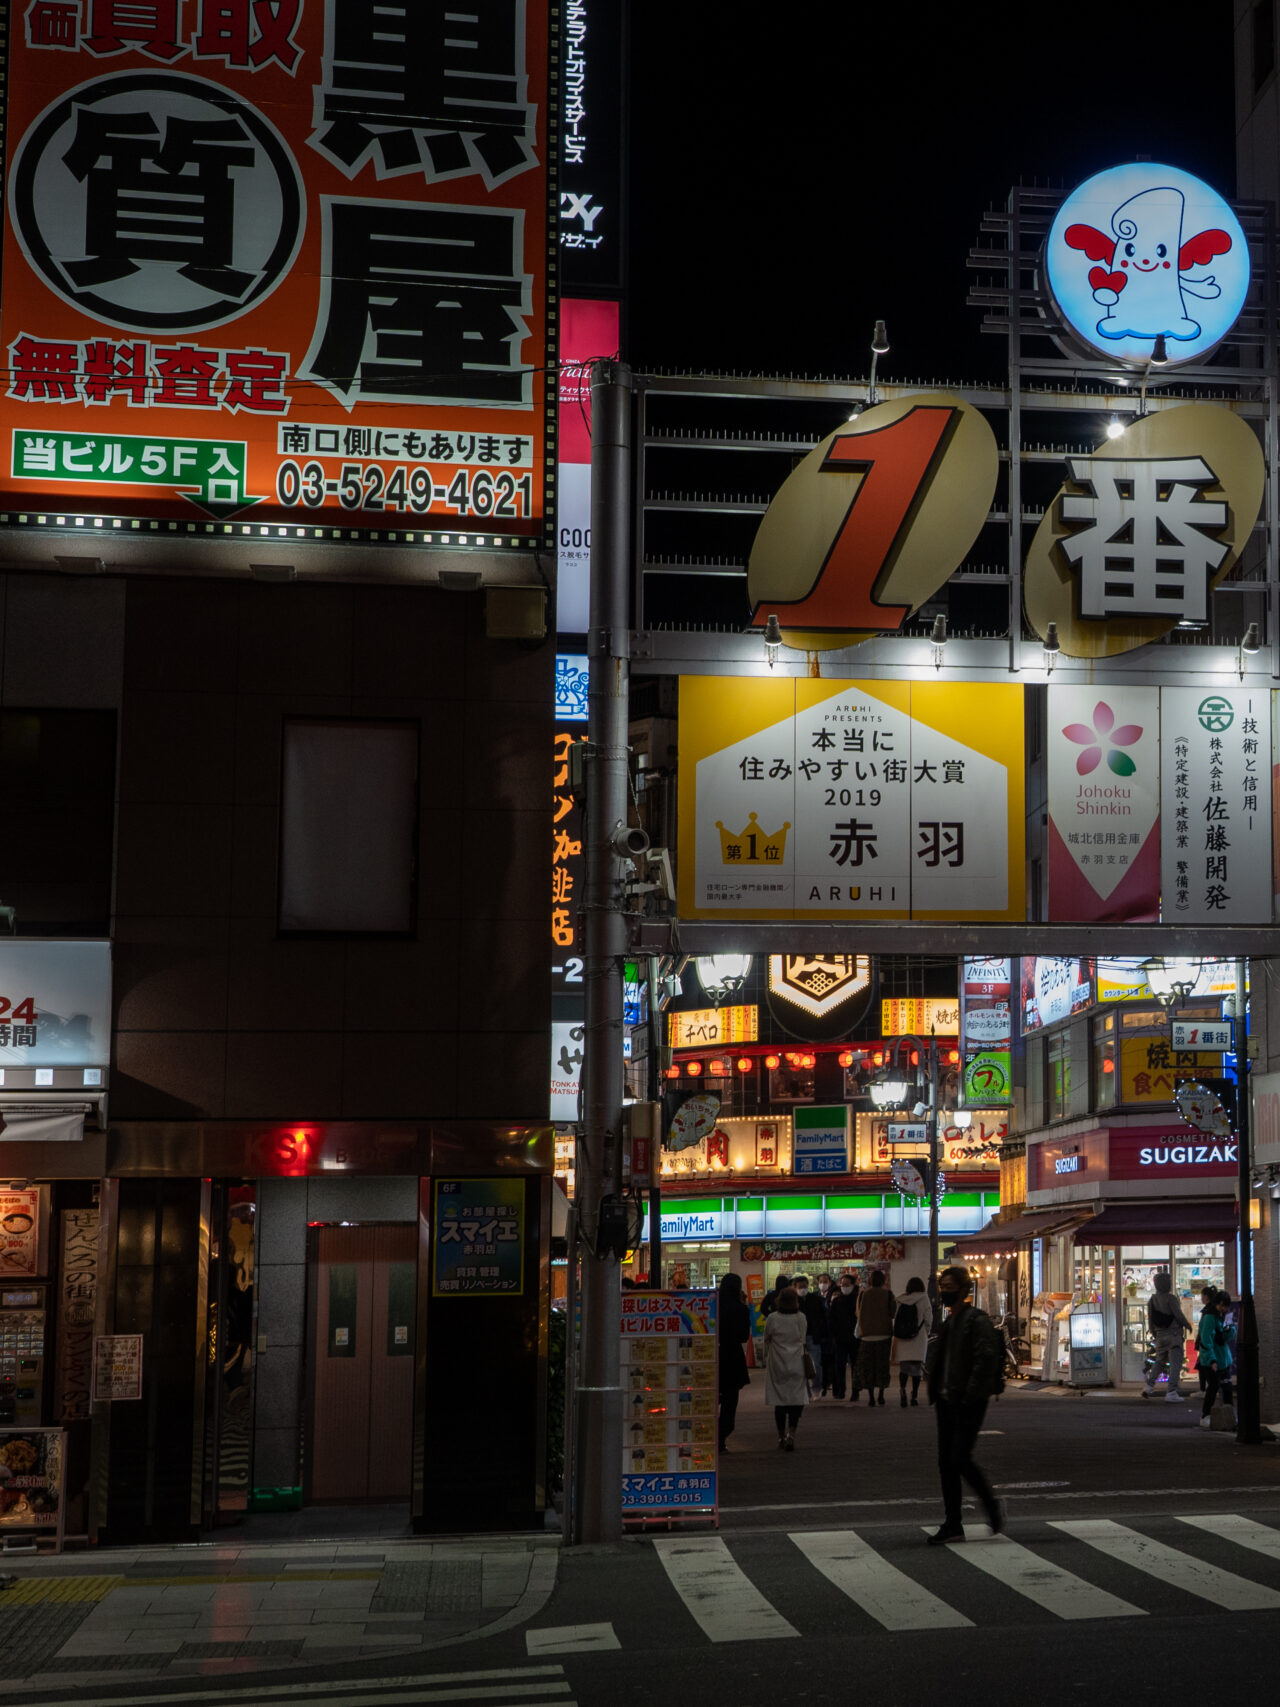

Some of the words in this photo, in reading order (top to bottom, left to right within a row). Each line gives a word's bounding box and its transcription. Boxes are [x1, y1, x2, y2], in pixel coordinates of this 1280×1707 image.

[60, 107, 268, 304] 質
[8, 336, 290, 413] 無料査定
[281, 424, 531, 463] 南口側にもあります
[22, 437, 200, 476] 当ビル5F
[207, 447, 241, 505] 入口
[276, 460, 532, 518] 03-5249-4621
[836, 705, 872, 713] ARUHI
[824, 715, 883, 723] PRESENTS
[811, 727, 895, 753] 本当に
[739, 756, 966, 784] 住みやすい街大賞
[824, 788, 882, 806] 2019
[1076, 784, 1131, 799] Johoku
[1076, 801, 1131, 815] Shinkin
[828, 818, 965, 867] 赤羽
[1068, 832, 1140, 845] 城北信用金庫
[726, 832, 781, 861] 第1位
[1080, 855, 1128, 865] 赤羽支店
[809, 886, 896, 900] ARUHI
[967, 967, 1007, 977] INFINITY
[982, 985, 995, 993] 3F
[1175, 1026, 1185, 1045] 赤羽
[1187, 1029, 1229, 1045] 1番街
[797, 1133, 845, 1144] FamilyMart
[1140, 1145, 1239, 1165] SUGIZAK
[801, 1159, 813, 1171] 酒
[817, 1159, 842, 1169] たばこ
[442, 1184, 456, 1192] 6F
[462, 1206, 518, 1217] お部屋探し
[440, 1220, 518, 1243] スマイエ
[463, 1245, 496, 1255] 赤羽店
[463, 1280, 518, 1290] リノベーション
[678, 1478, 710, 1489] 赤羽店
